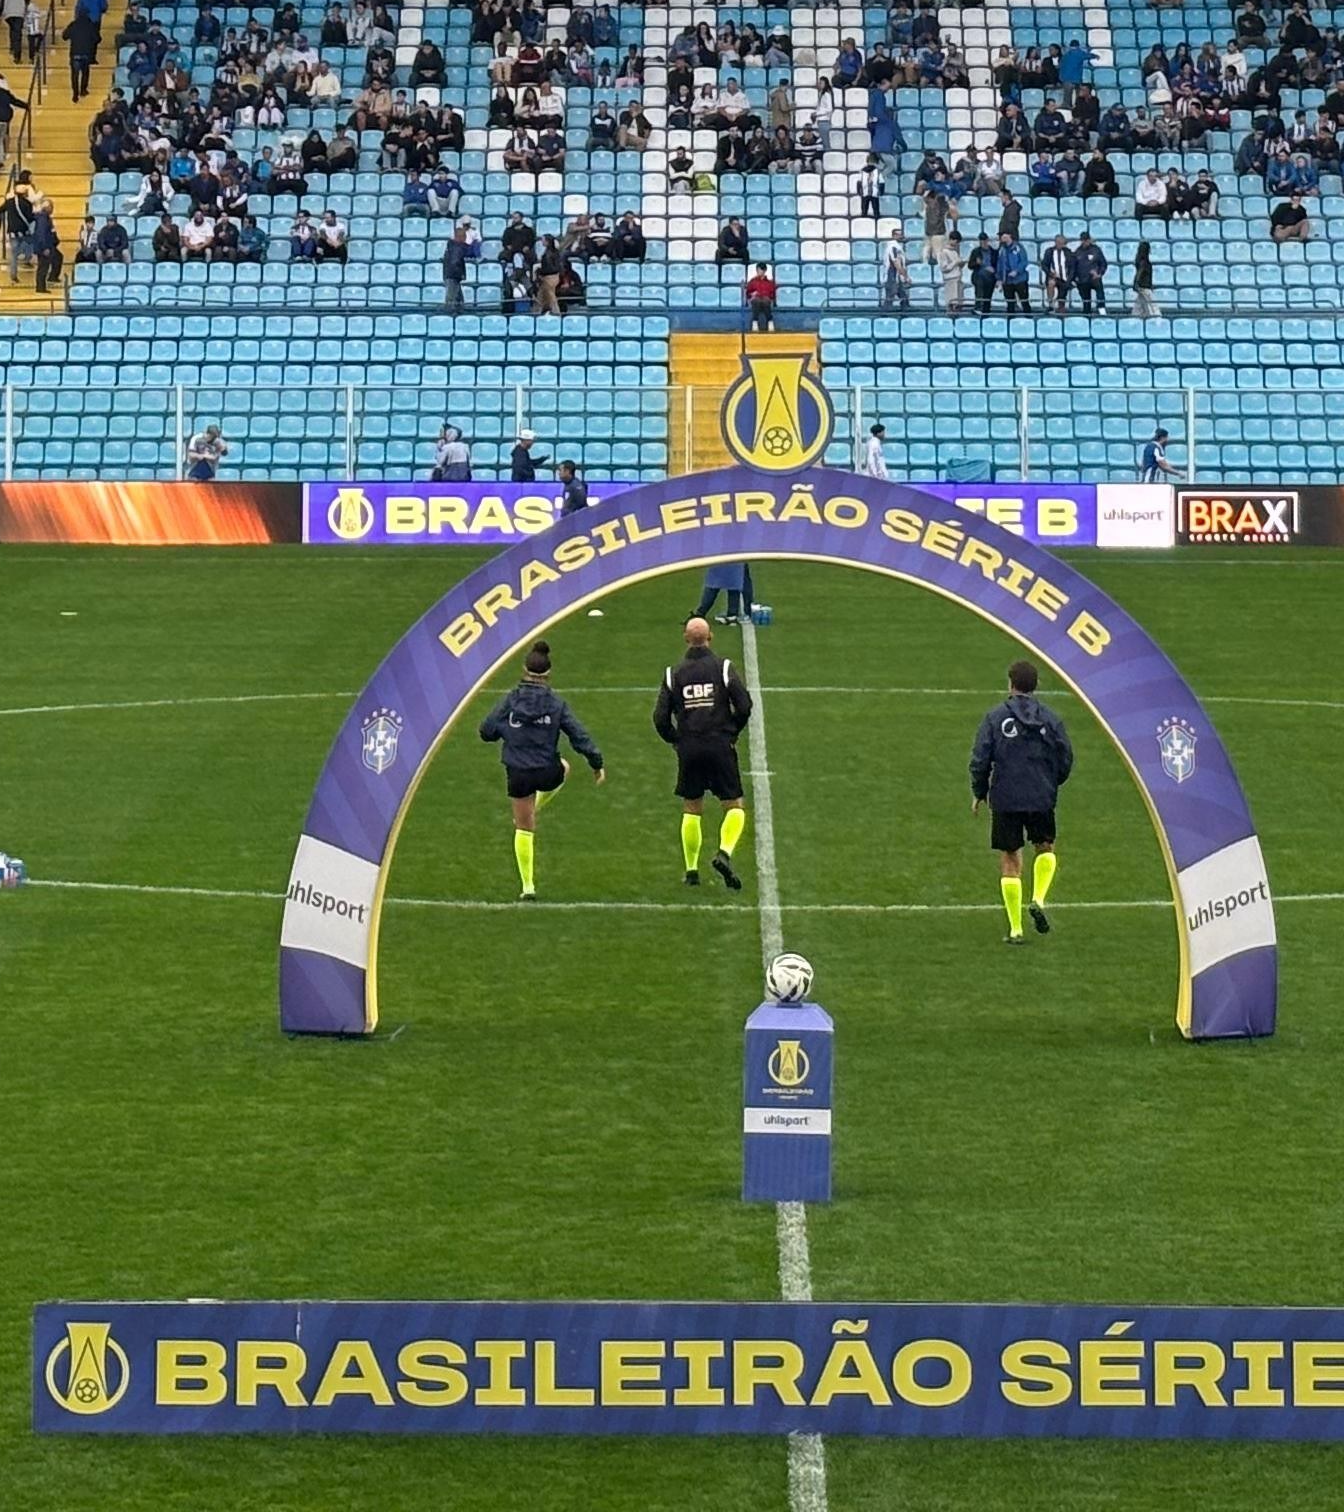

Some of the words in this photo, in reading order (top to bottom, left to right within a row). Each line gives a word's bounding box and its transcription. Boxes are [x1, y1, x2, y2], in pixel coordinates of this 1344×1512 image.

[1103, 508, 1162, 523] uhlsport
[1189, 499, 1288, 533] BRAX
[437, 483, 869, 659] BRASILEIRÃO
[881, 505, 1070, 622] SÉRIE
[1066, 609, 1112, 657] B
[682, 684, 714, 699] CBF
[1188, 881, 1268, 931] uhlsport
[763, 1114, 808, 1127] uhlsport
[155, 1318, 972, 1409] BRASILEIRÃO
